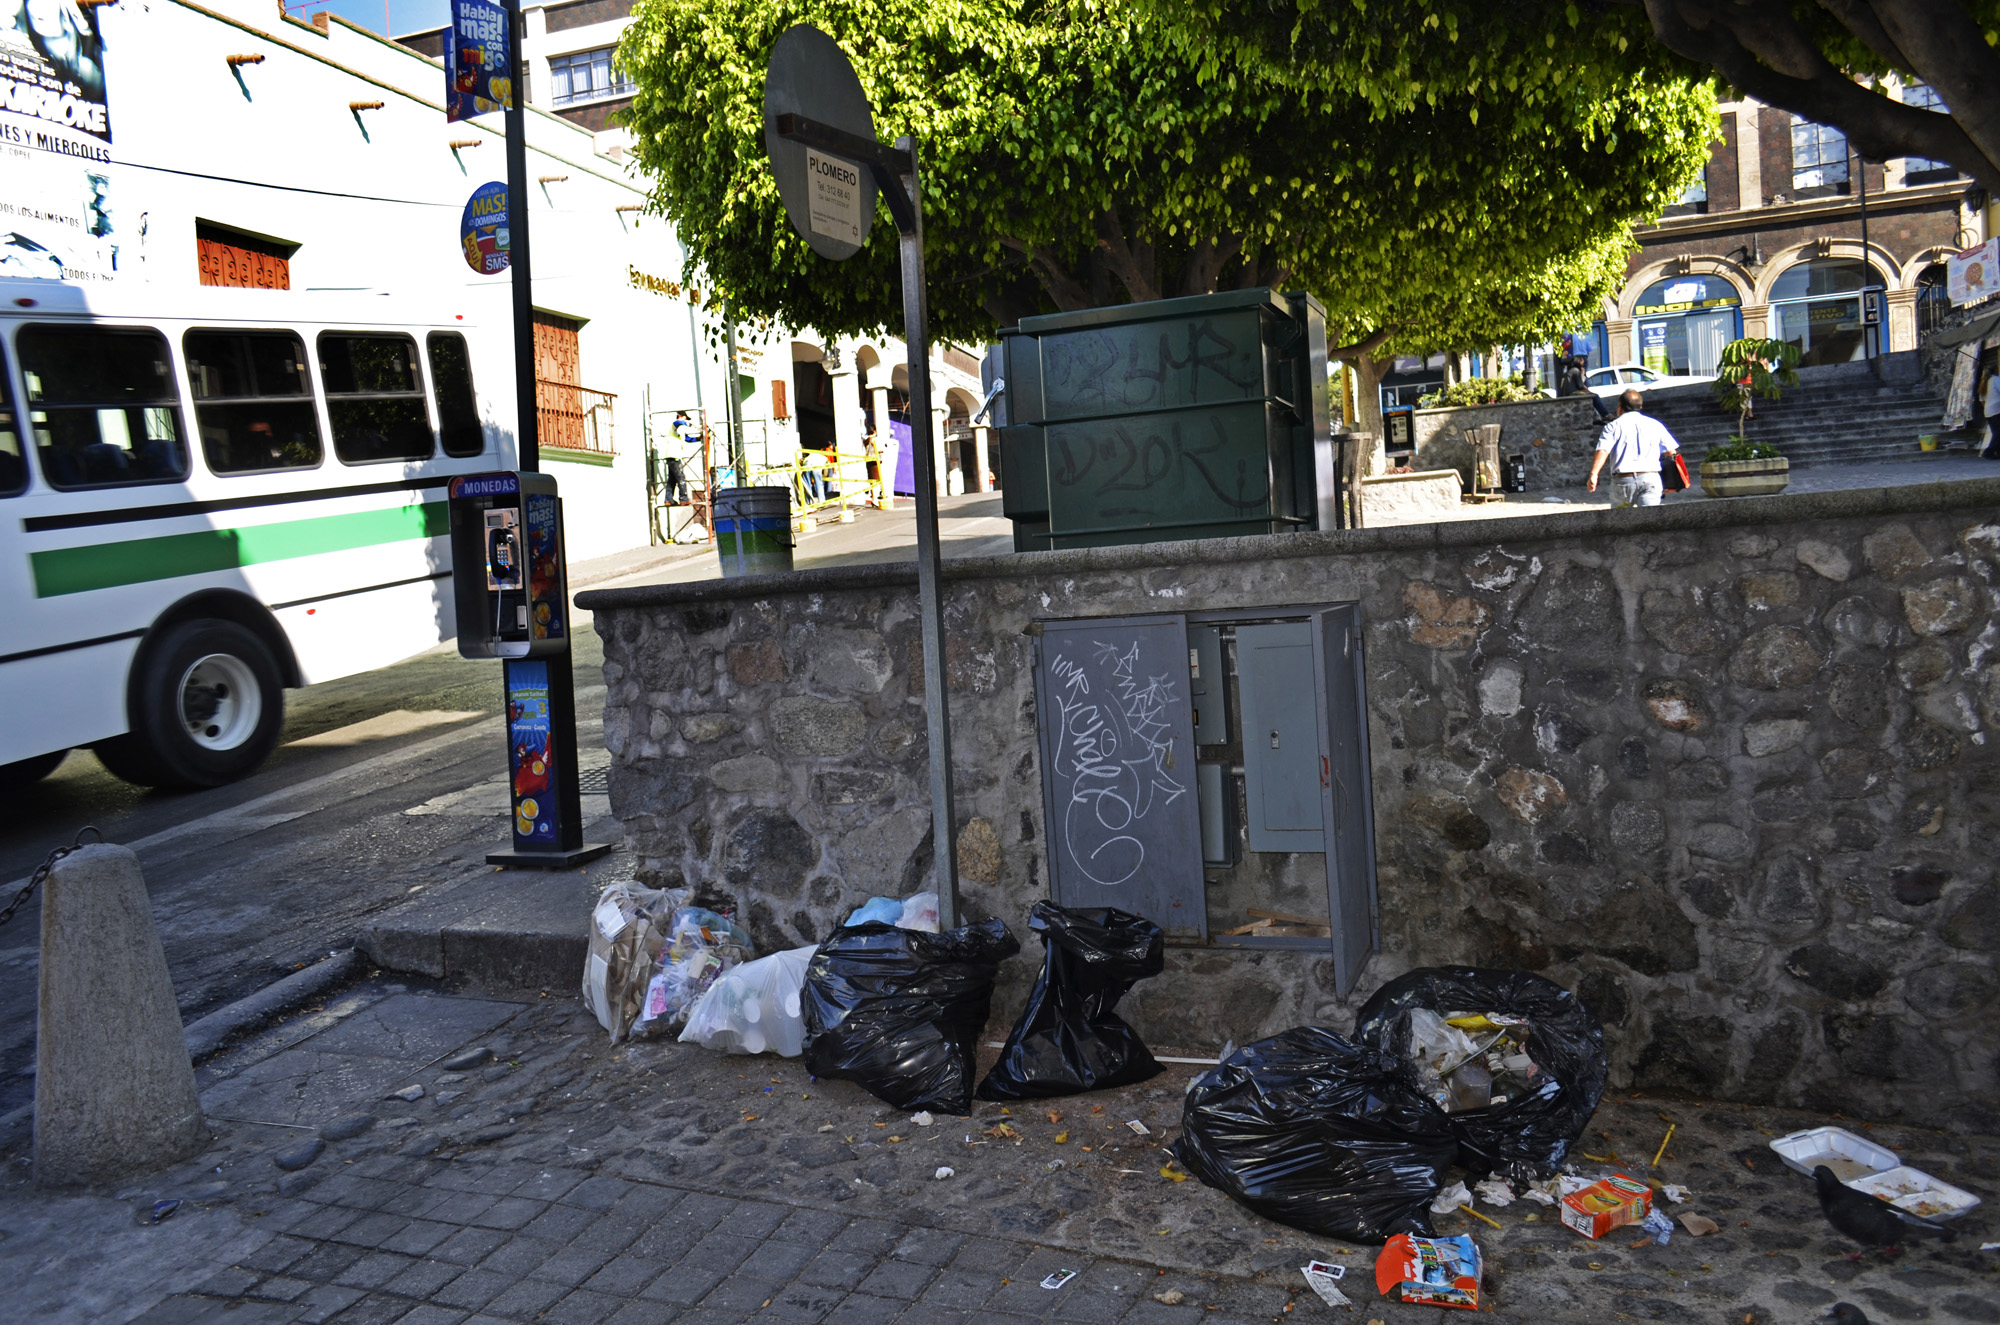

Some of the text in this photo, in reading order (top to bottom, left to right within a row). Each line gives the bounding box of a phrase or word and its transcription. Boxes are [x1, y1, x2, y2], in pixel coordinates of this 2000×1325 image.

[461, 3, 497, 22] Habla
[486, 41, 503, 51] con
[0, 63, 82, 97] oches son de
[24, 129, 31, 145] Y
[36, 132, 110, 163] MIERCOLES
[809, 157, 857, 186] PLOMERO
[472, 192, 506, 218] MÁS!
[34, 210, 80, 228] ALIMENTOS
[475, 212, 507, 227] DOMINGOS
[486, 255, 509, 271] SMS
[464, 479, 516, 494] MONEDAS
